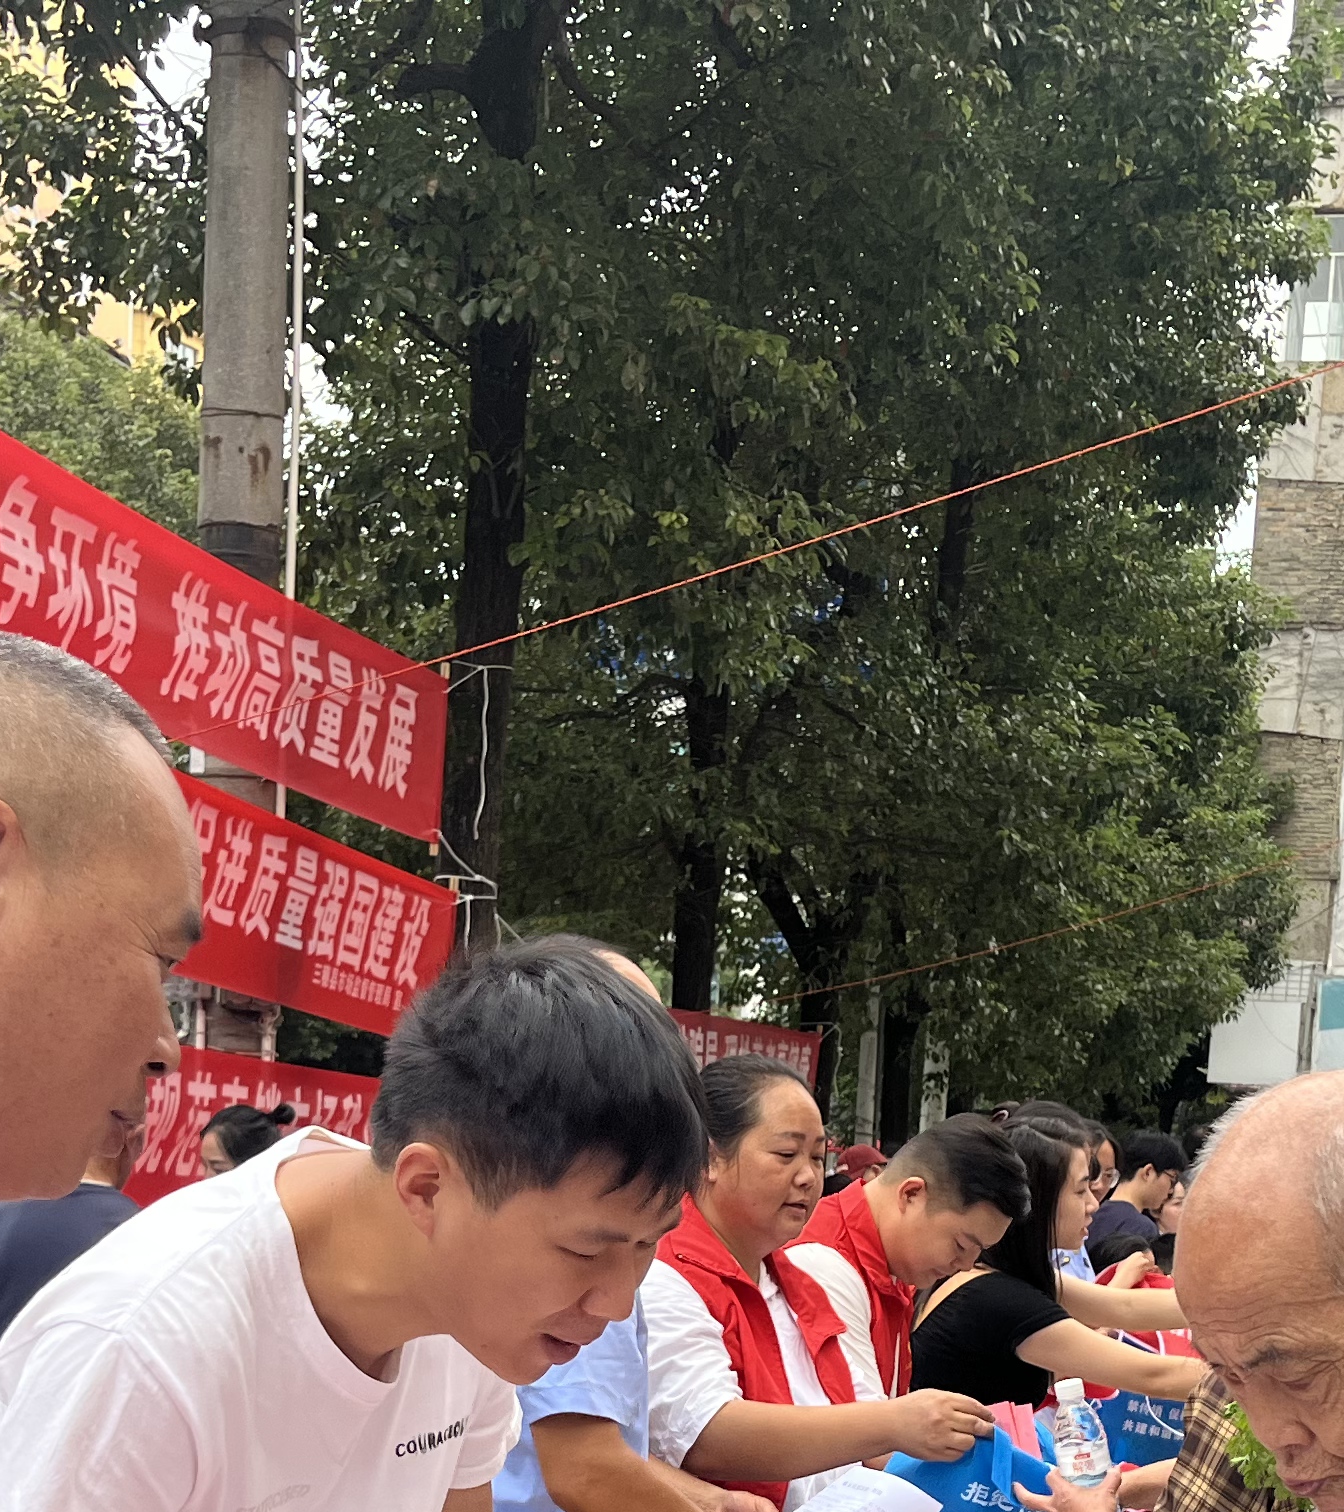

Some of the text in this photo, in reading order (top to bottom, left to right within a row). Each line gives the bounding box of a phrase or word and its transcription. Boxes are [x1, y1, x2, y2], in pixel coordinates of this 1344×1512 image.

[160, 570, 419, 800] 推动高质量发展
